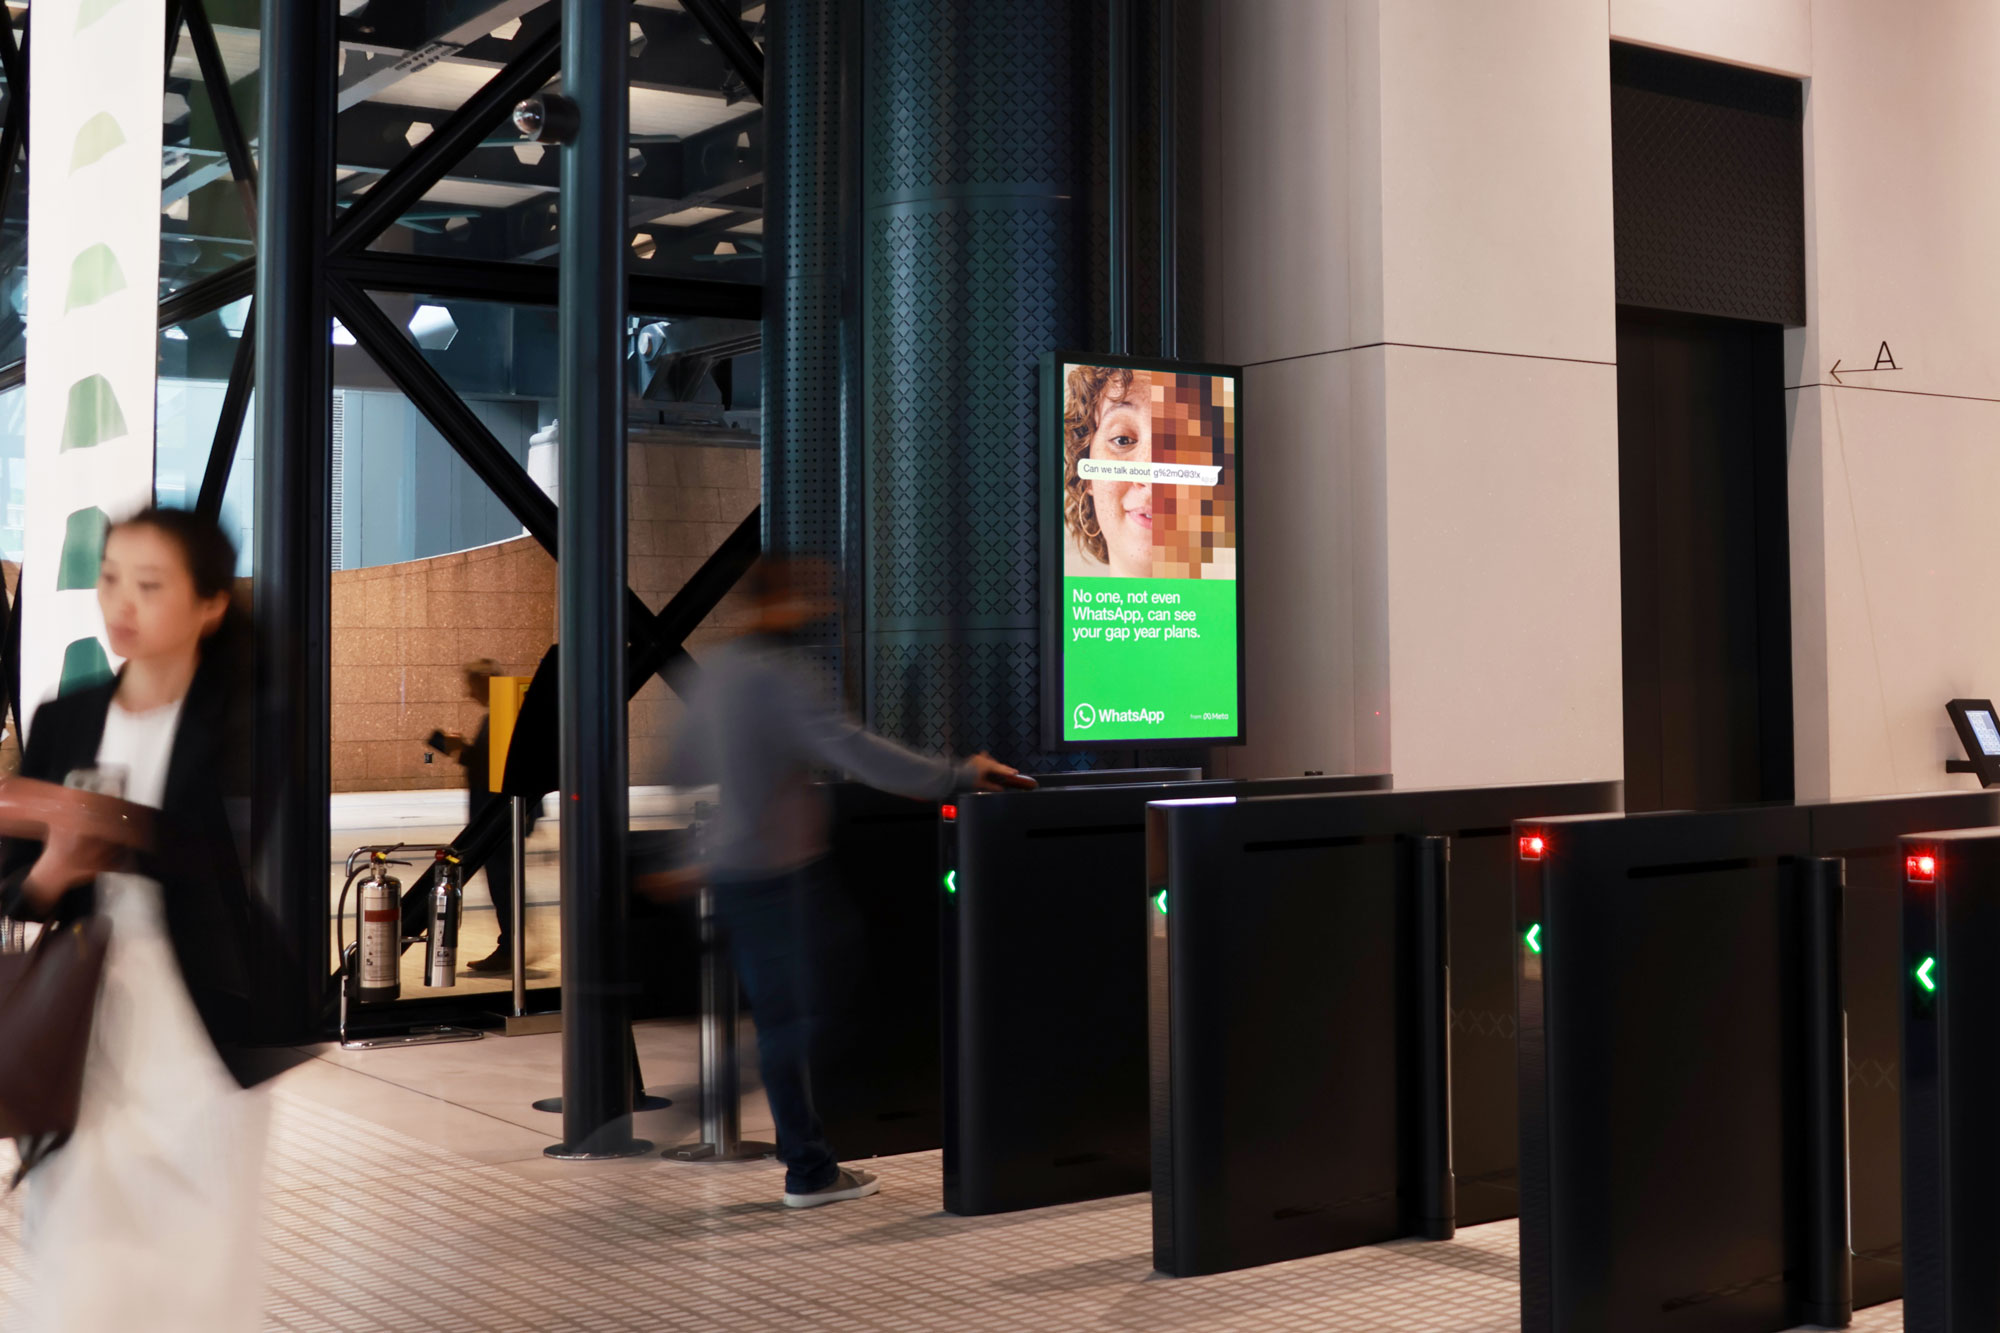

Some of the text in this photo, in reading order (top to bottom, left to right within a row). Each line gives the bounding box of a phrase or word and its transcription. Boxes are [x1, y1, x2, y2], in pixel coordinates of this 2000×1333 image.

[1874, 341, 1896, 370] A
[1083, 464, 1099, 474] Can
[1101, 466, 1112, 474] we
[1114, 466, 1128, 475] talk
[1129, 466, 1150, 476] about
[1072, 589, 1181, 605] No one, not even
[1072, 607, 1196, 624] WhatsApp, can see
[1072, 625, 1201, 641] your gap year plans.
[1098, 709, 1165, 724] WhatsApp
[1212, 712, 1229, 720] Meta
